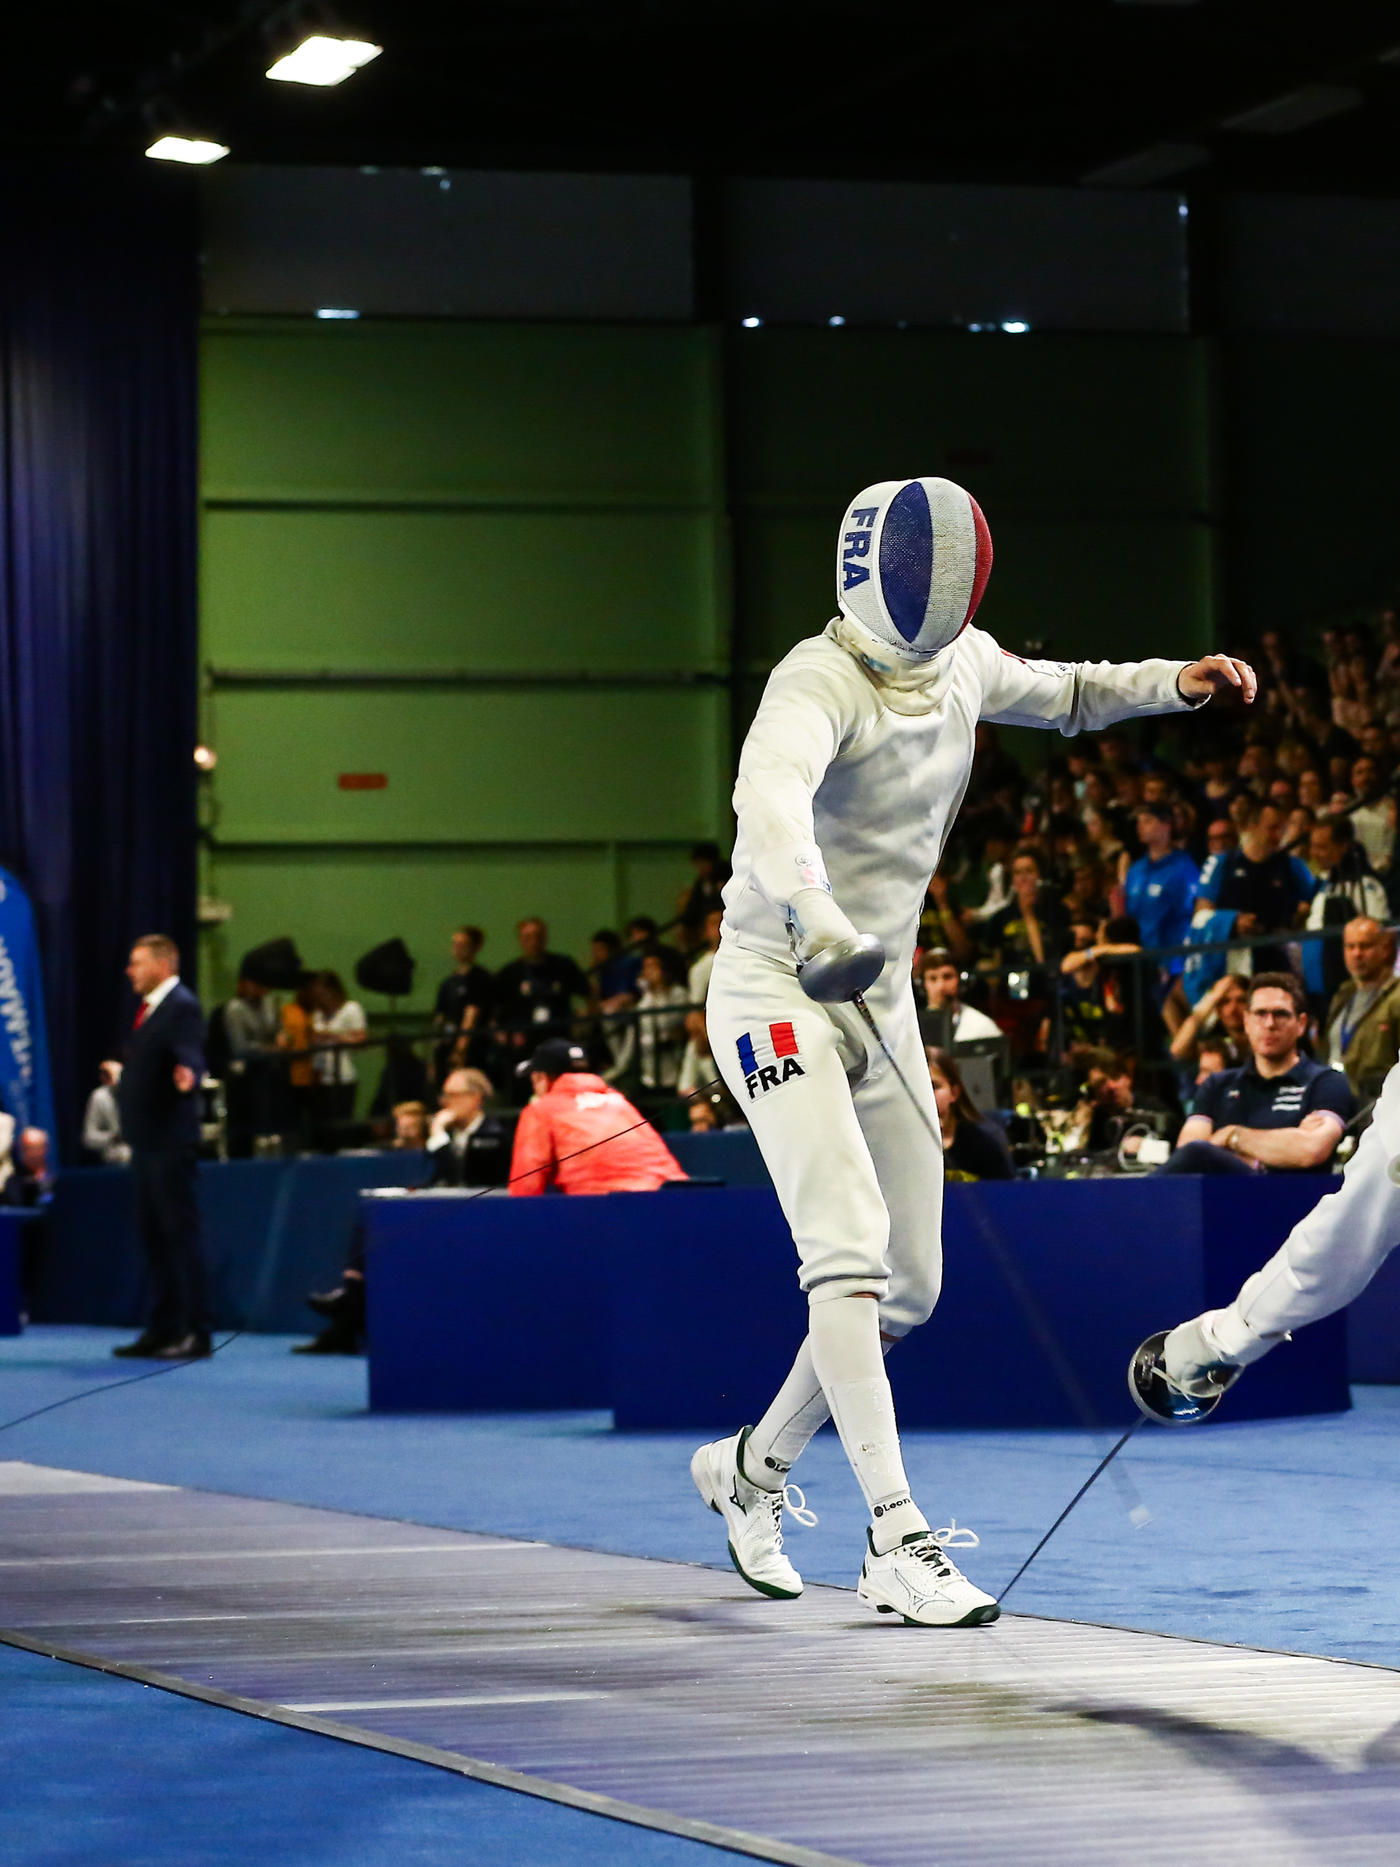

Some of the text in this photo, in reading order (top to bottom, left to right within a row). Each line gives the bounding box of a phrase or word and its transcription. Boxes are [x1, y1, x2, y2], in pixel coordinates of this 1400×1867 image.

[843, 507, 879, 591] FRA
[745, 1058, 805, 1099] FRA
[883, 1498, 910, 1511] Leon
